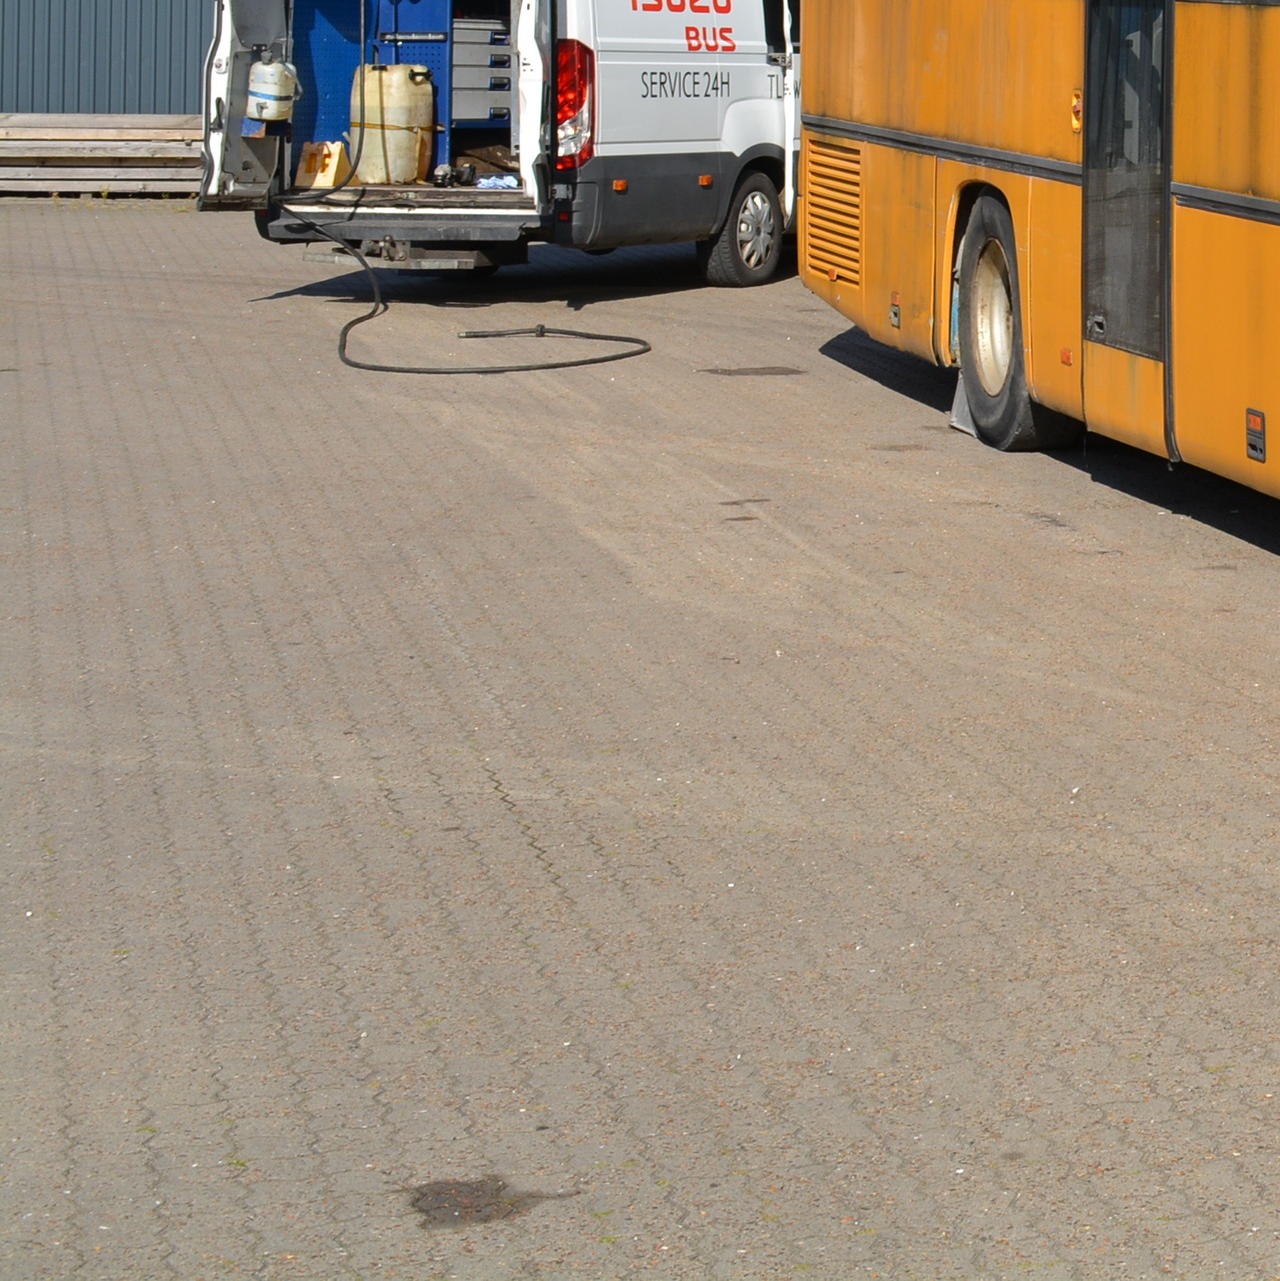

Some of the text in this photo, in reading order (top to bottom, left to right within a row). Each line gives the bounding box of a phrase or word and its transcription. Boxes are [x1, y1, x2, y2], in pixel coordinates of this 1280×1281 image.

[685, 26, 736, 52] BUS
[641, 71, 731, 99] SERVICE 24H
